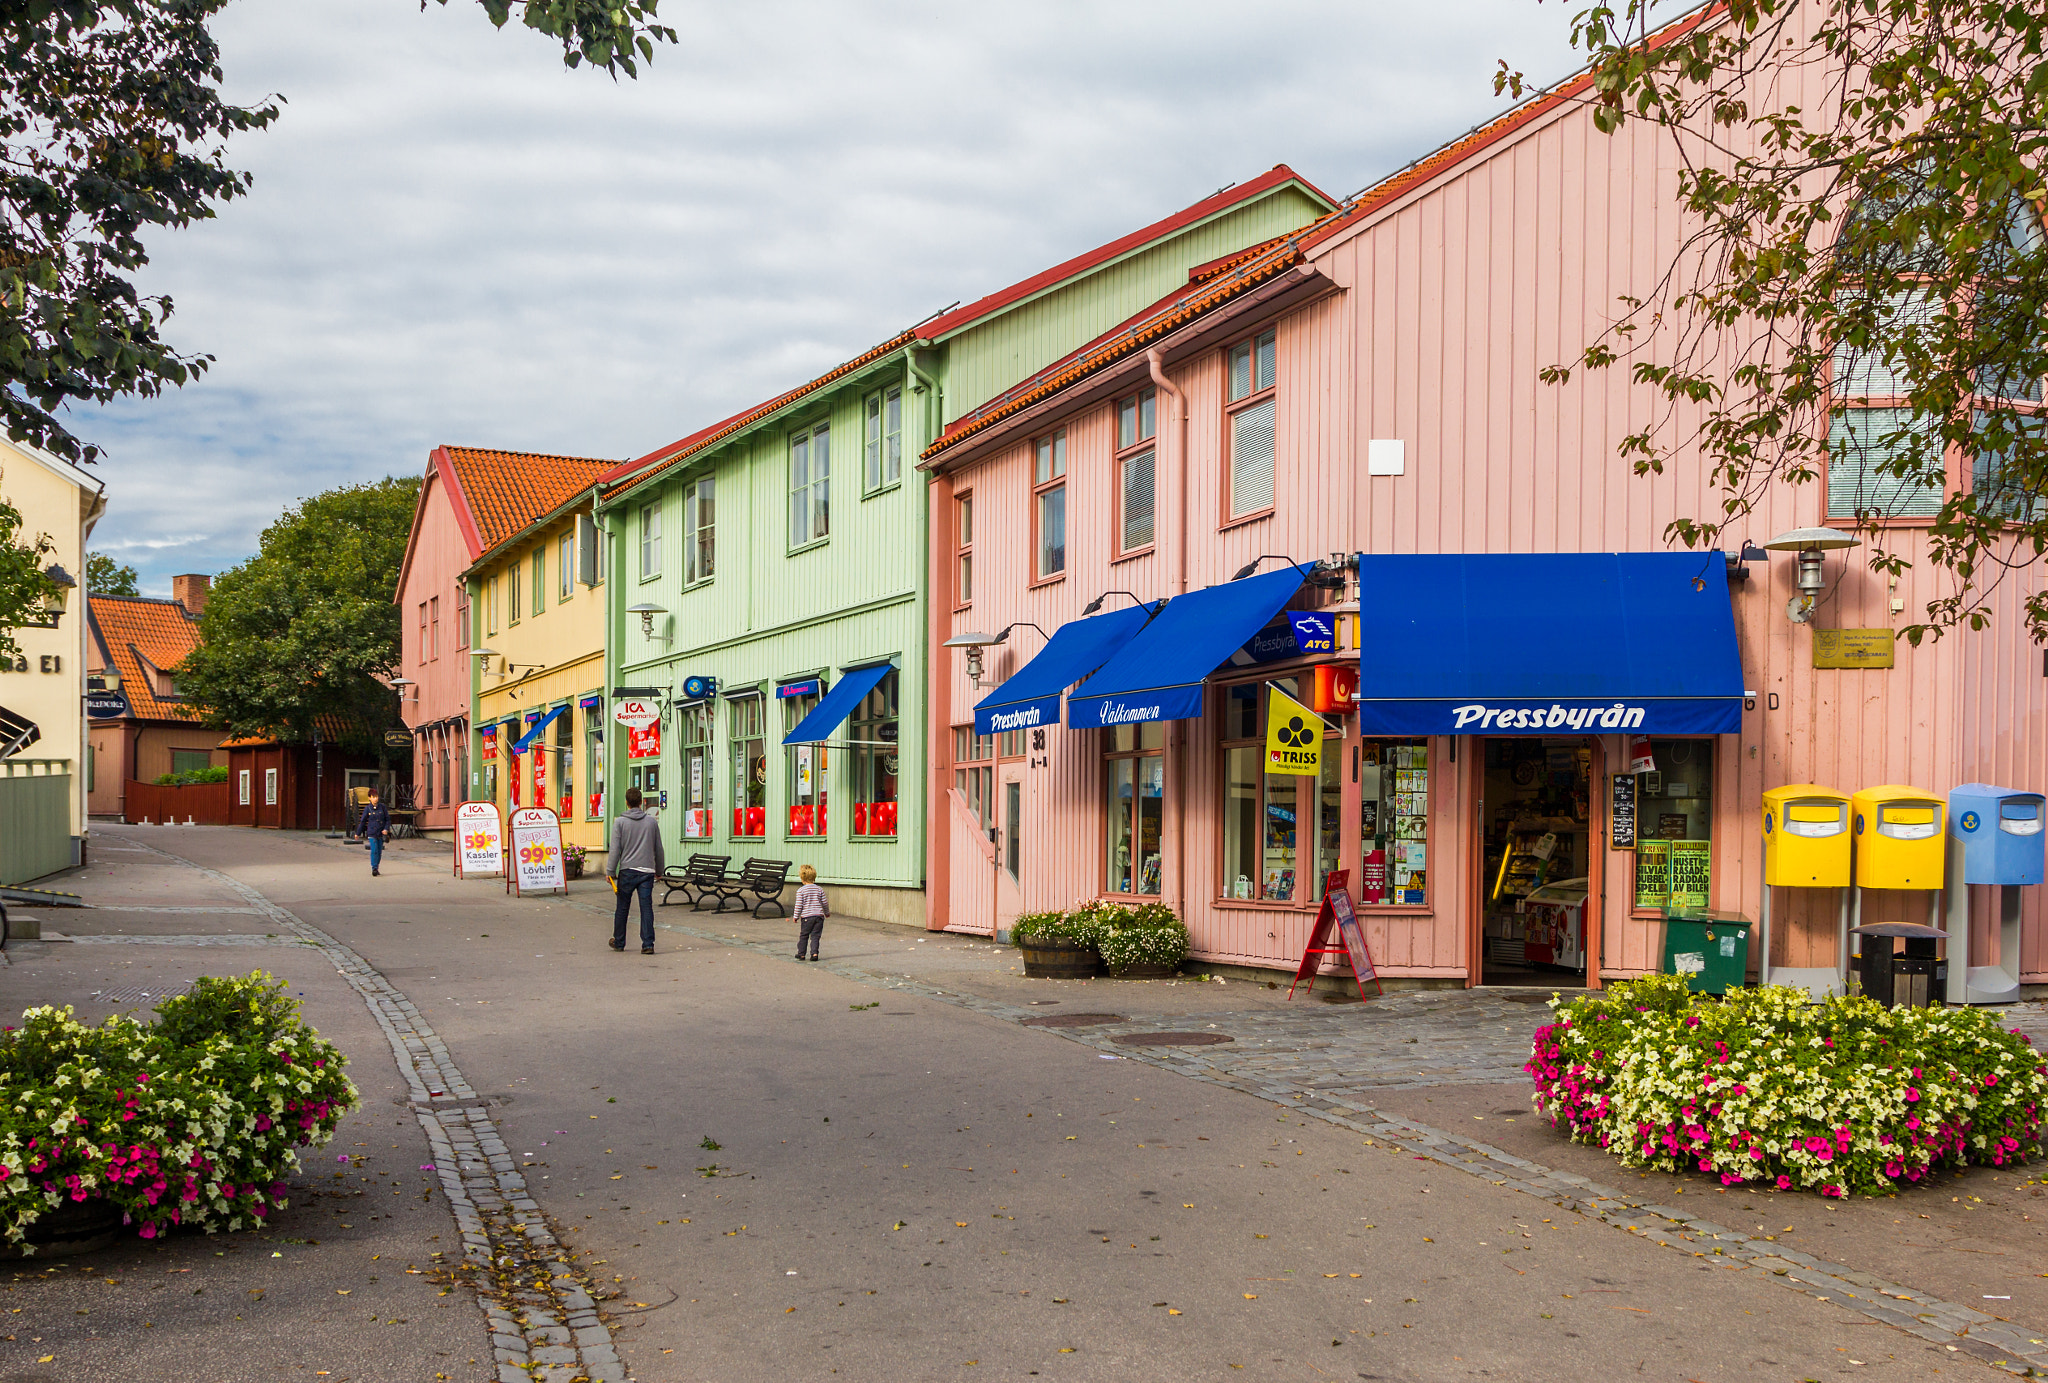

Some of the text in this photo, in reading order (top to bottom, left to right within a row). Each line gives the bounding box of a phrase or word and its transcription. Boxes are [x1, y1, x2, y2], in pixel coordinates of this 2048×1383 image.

[1305, 640, 1331, 650] ATG
[1769, 693, 1779, 710] D
[625, 702, 645, 713] ICA
[1100, 700, 1160, 725] Välkommen
[617, 712, 658, 721] Supermarket
[991, 706, 1041, 732] Pressbyrån
[1452, 703, 1646, 730] Pressbyrån
[1033, 729, 1046, 751] 38
[1282, 751, 1317, 764] TRISS
[469, 805, 484, 813] ICA
[525, 812, 542, 821] ICA
[519, 829, 552, 843] Super
[466, 851, 499, 859] Kassler
[1673, 857, 1699, 866] HUSET
[523, 866, 556, 875] Lövbiff
[1636, 866, 1668, 875] SILVIAS
[1673, 884, 1709, 892] AV BILEN
